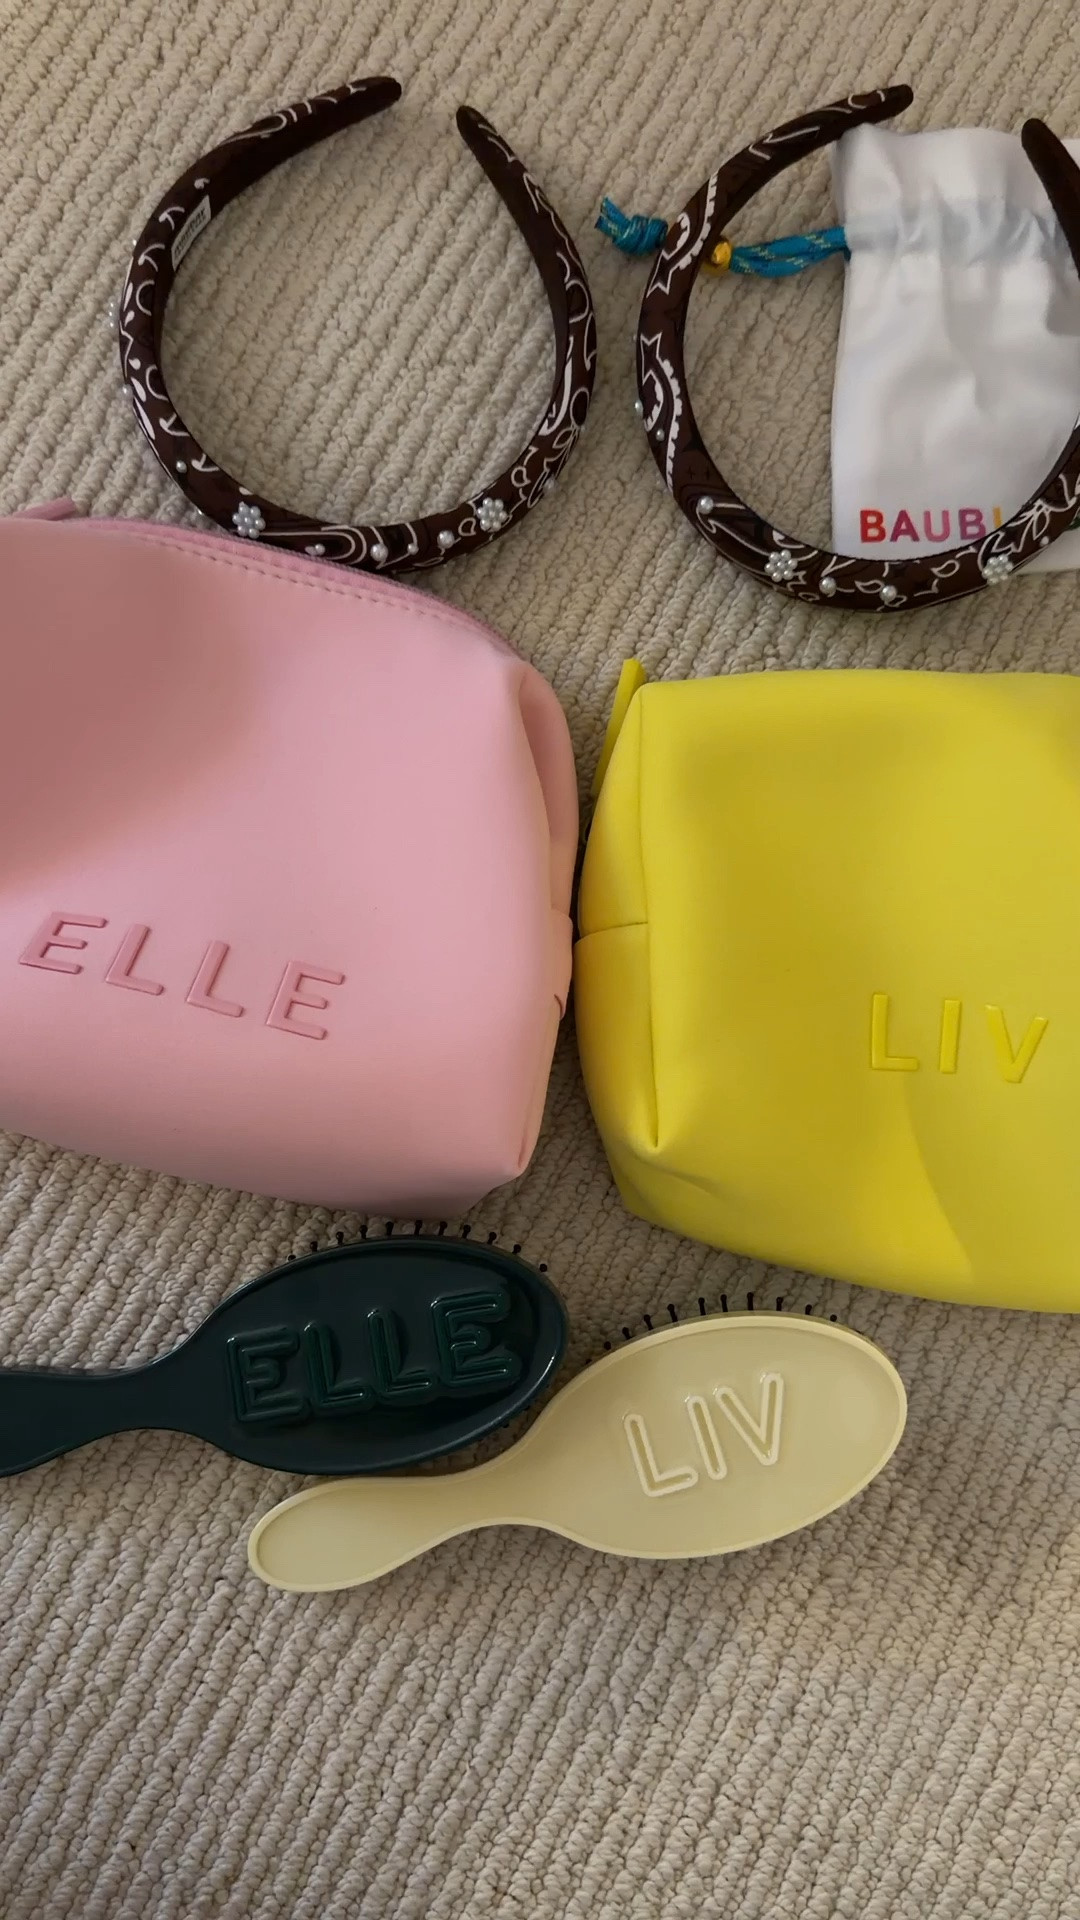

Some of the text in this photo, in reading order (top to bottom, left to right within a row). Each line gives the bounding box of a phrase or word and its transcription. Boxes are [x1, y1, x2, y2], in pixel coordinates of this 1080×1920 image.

[19, 911, 346, 1041] ELLE
[870, 992, 1049, 1084] LIV
[226, 1289, 523, 1424] ELLE
[622, 1370, 784, 1497] LIV
